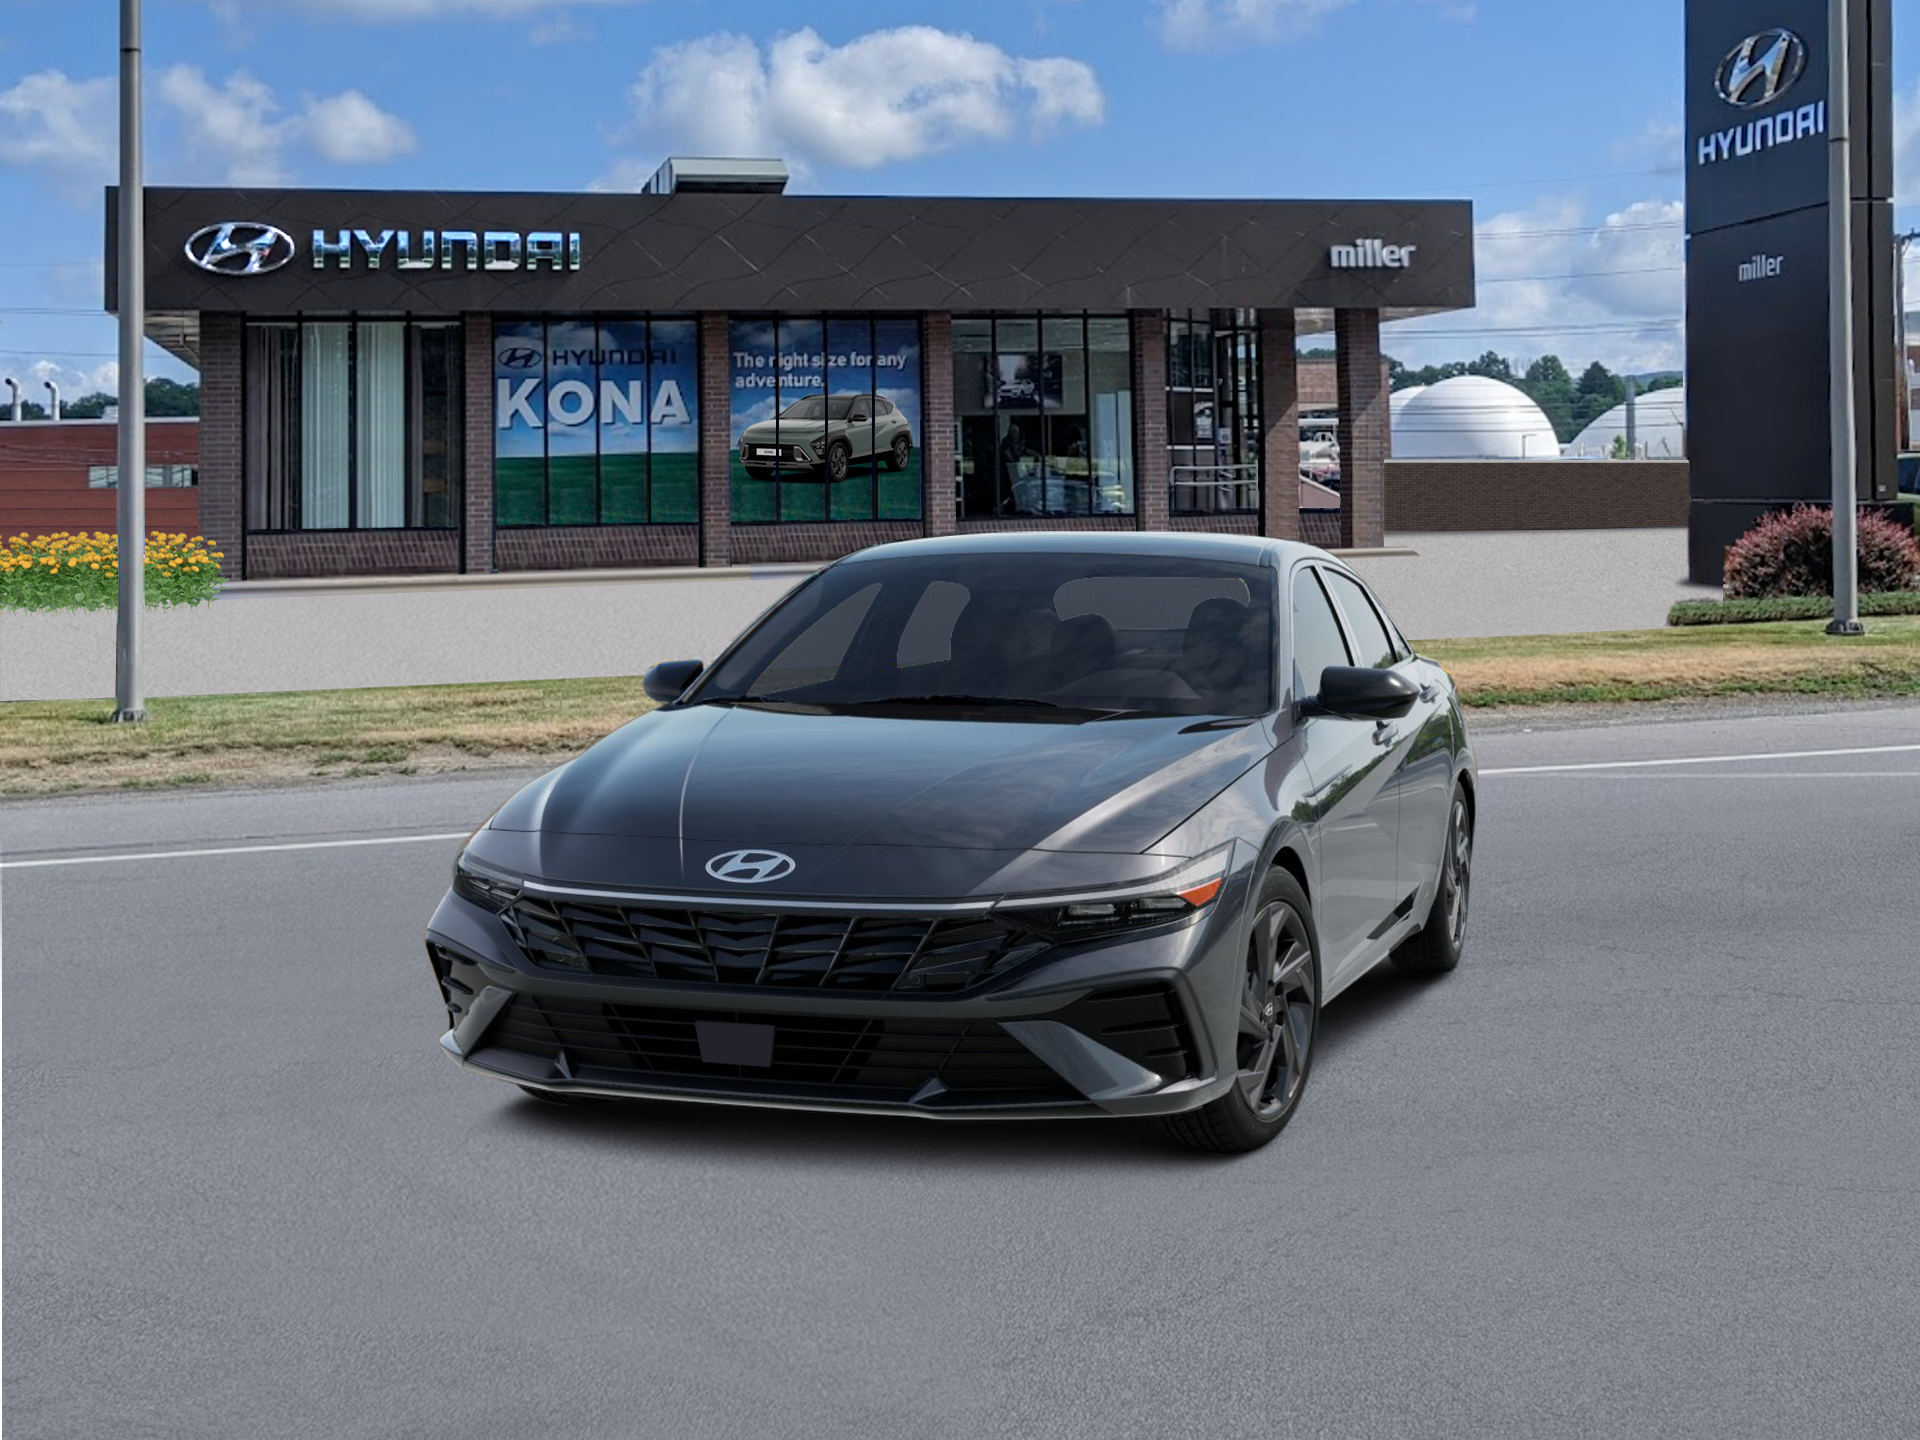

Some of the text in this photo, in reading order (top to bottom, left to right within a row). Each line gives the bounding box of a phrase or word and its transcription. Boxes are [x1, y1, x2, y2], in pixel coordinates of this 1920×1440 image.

[1698, 100, 1825, 165] HYUNDAI
[312, 229, 580, 271] HYUNDAI
[1330, 238, 1417, 268] miller
[1739, 254, 1784, 282] miller
[552, 349, 677, 365] HYUNDAI
[734, 351, 906, 370] The right size for any
[735, 373, 825, 389] adventure.
[498, 377, 691, 429] KONA
